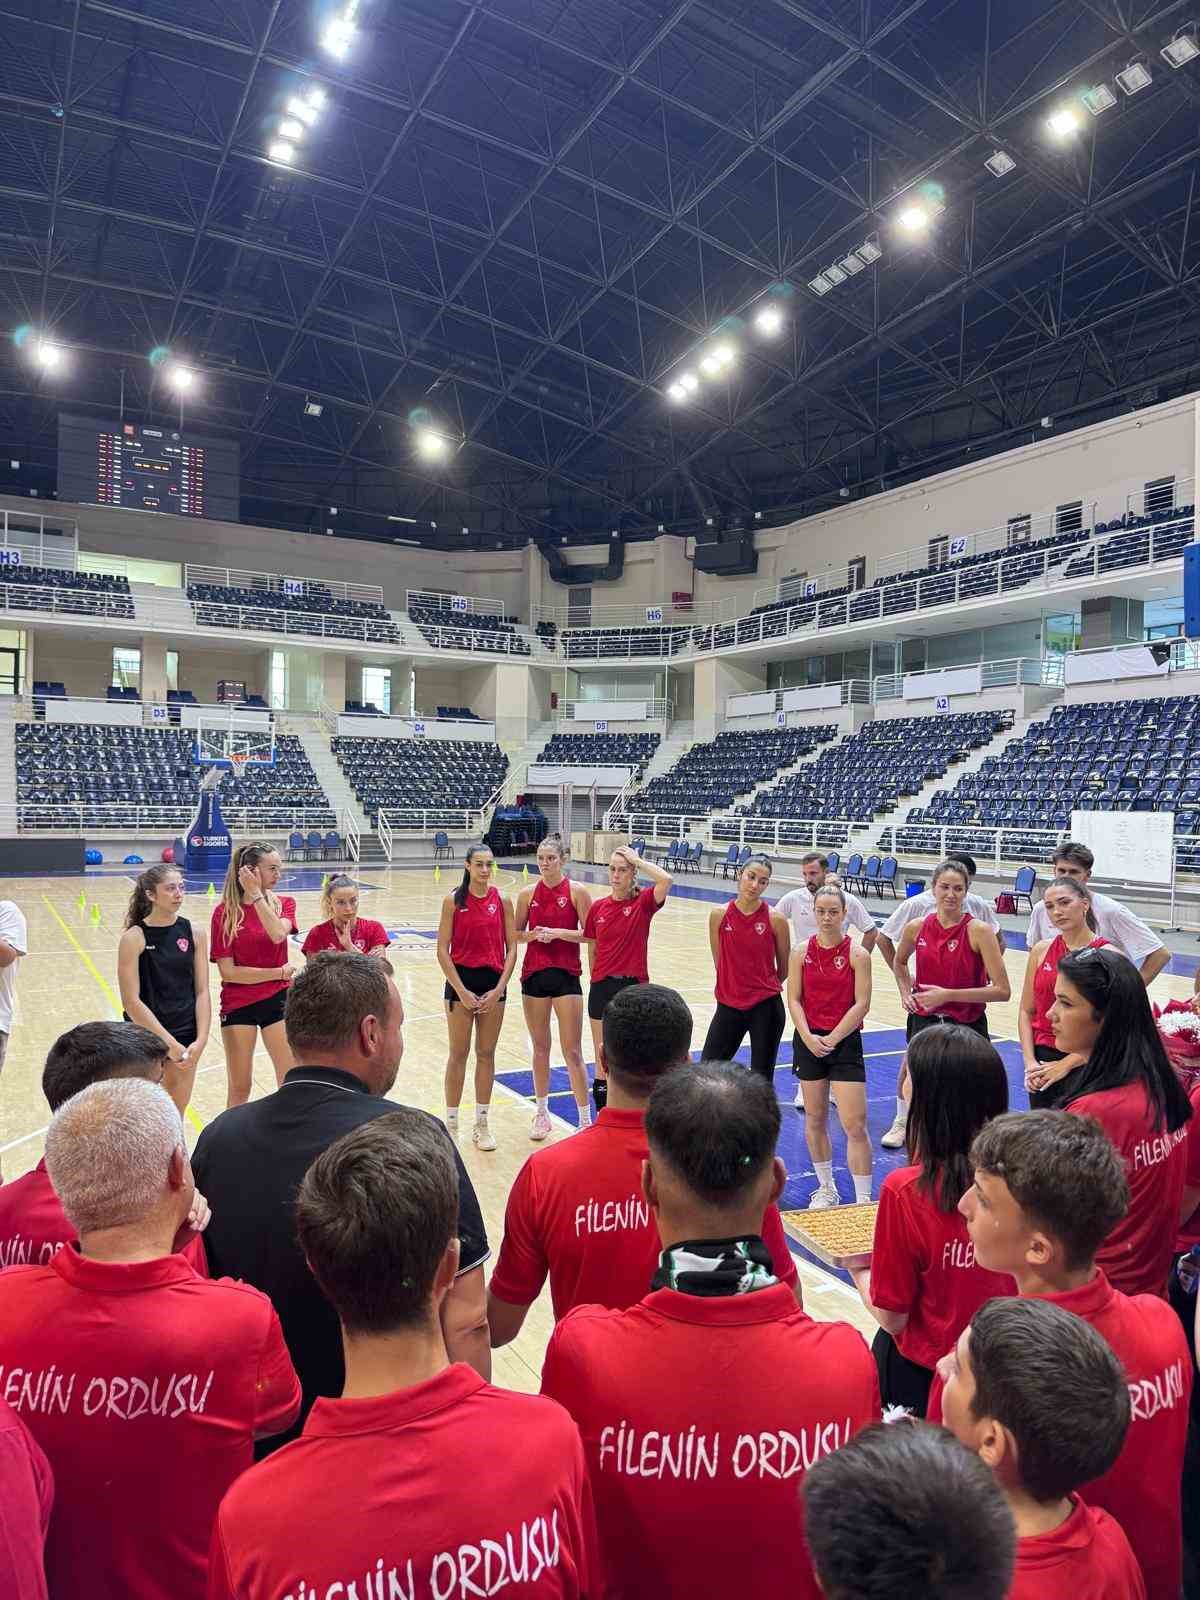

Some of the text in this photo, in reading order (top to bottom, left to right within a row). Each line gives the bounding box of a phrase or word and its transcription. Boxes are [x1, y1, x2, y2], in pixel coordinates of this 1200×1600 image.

[950, 540, 967, 555] E2
[0, 551, 20, 564] H3
[285, 583, 302, 594] H4
[806, 583, 816, 596] E1
[453, 599, 467, 610] H5
[647, 610, 661, 621] H6
[936, 698, 947, 710] A2
[153, 708, 166, 718] D3
[596, 722, 606, 730] D5
[574, 1193, 649, 1237] FİLENİN
[0, 1364, 214, 1420] ENİN ORDUSU
[599, 1420, 720, 1481] FİLENİN
[429, 1508, 560, 1600] ORDUSU
